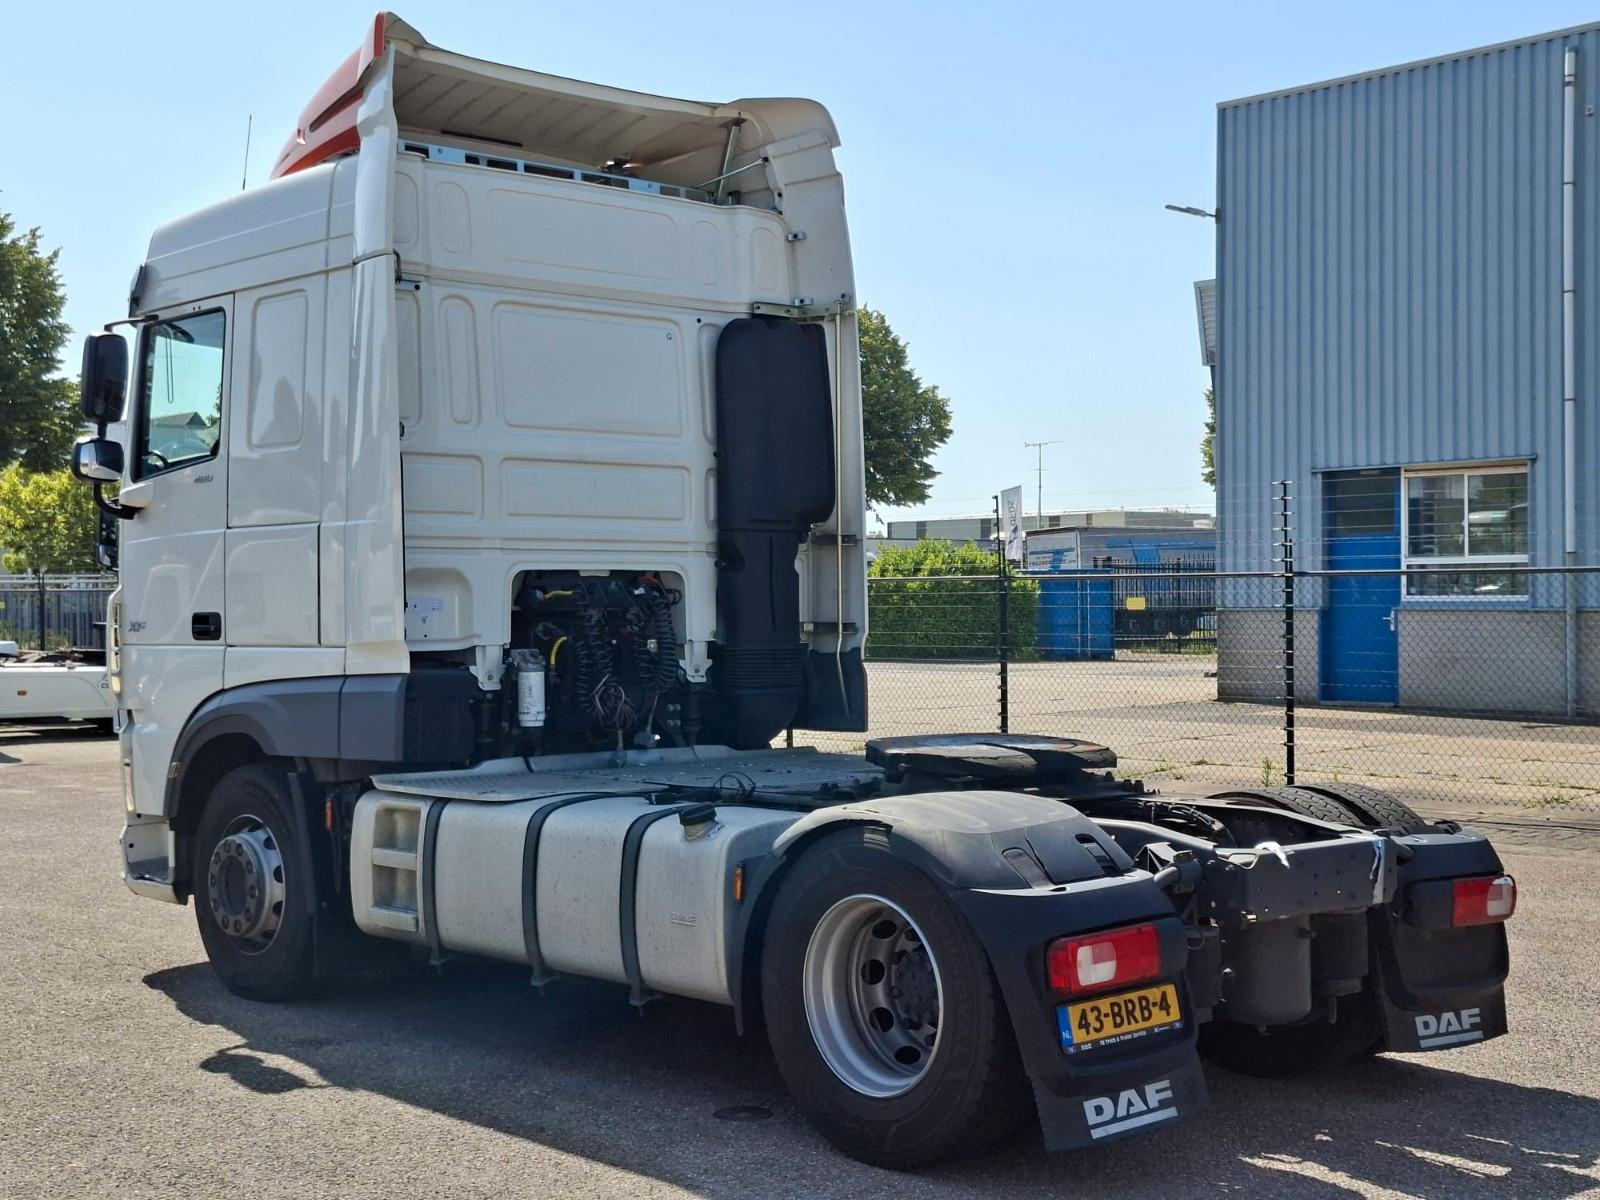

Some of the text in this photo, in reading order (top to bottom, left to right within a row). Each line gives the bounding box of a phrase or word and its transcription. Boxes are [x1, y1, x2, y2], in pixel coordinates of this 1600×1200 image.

[1077, 990, 1171, 1036] 43-BRB-4
[1415, 1008, 1481, 1036] DAF
[1062, 1029, 1072, 1040] NL
[1083, 1080, 1173, 1126] DAF
